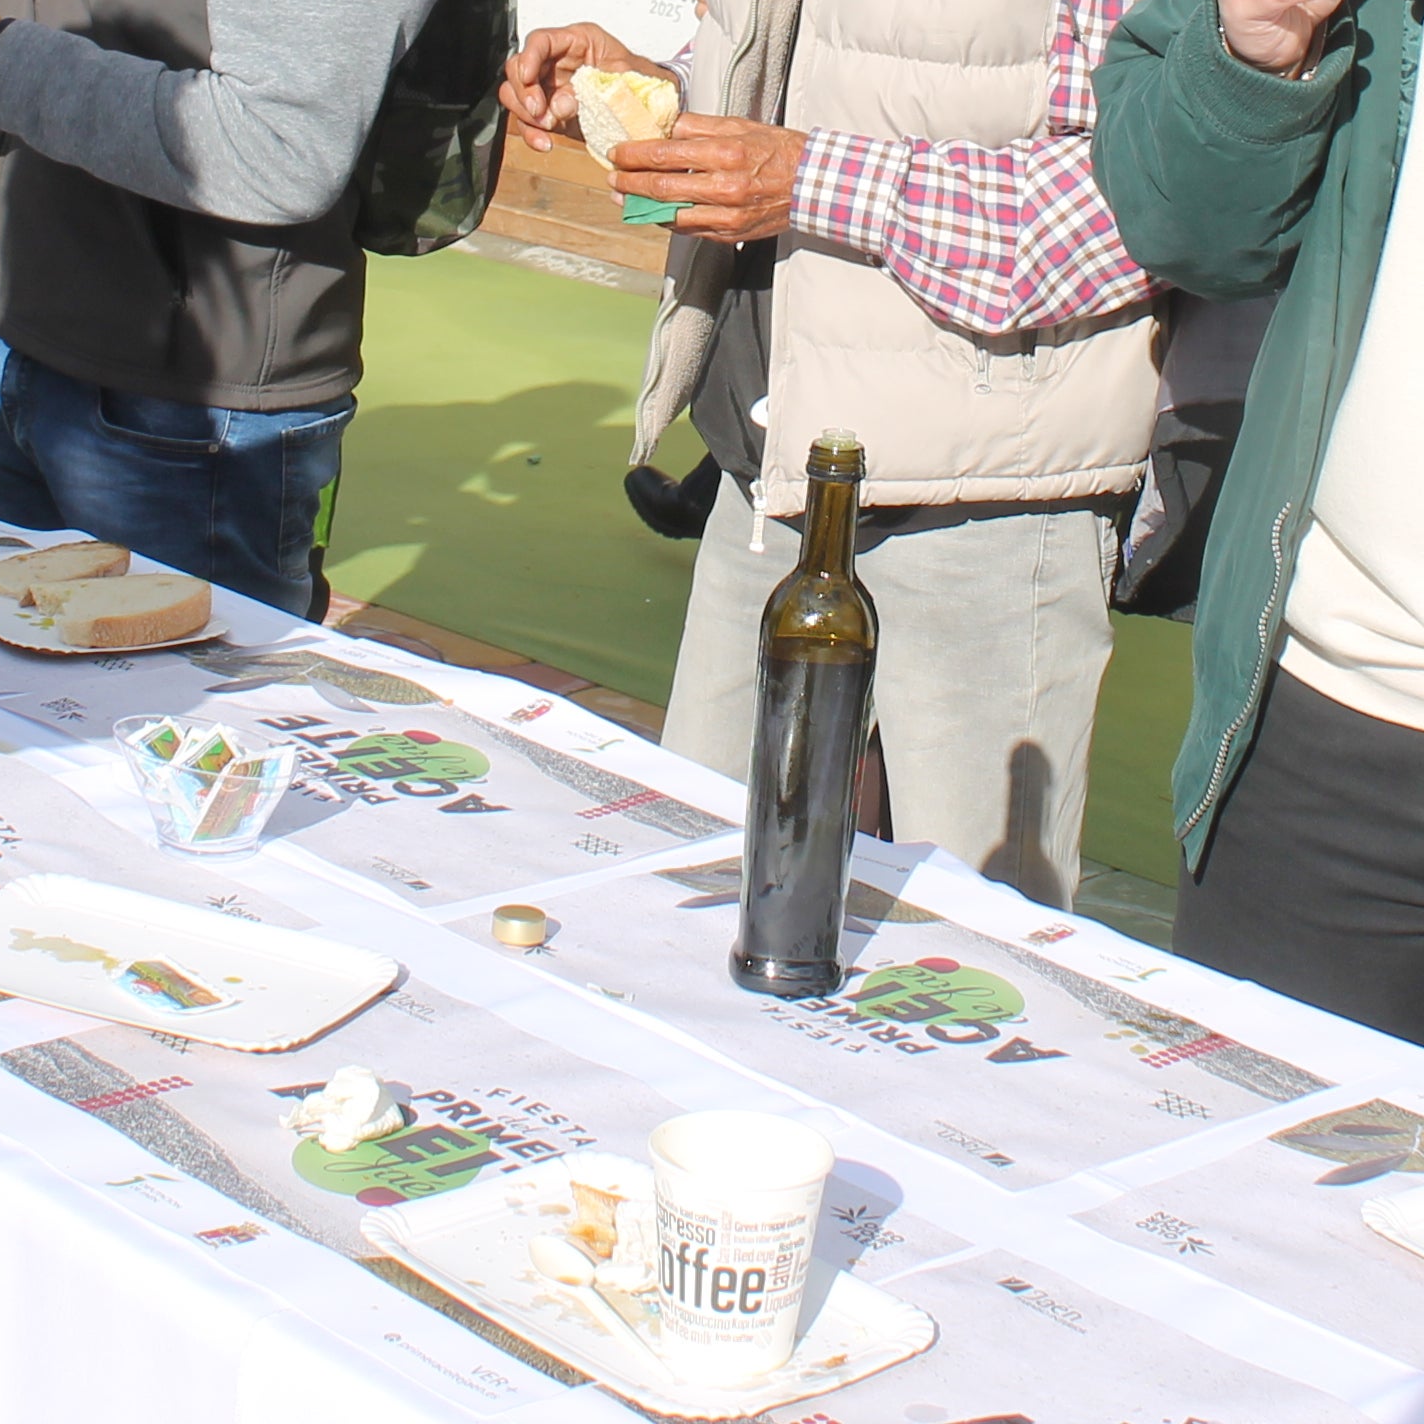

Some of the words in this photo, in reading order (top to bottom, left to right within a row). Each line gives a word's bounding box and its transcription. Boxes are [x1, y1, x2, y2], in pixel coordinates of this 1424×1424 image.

[254, 713, 514, 814] ACEITE
[760, 1004, 867, 1054] FIESTA
[796, 998, 940, 1055] PRIME
[410, 1088, 567, 1165] PRIME
[486, 1087, 598, 1148] FIESTA
[659, 1241, 766, 1314] offee
